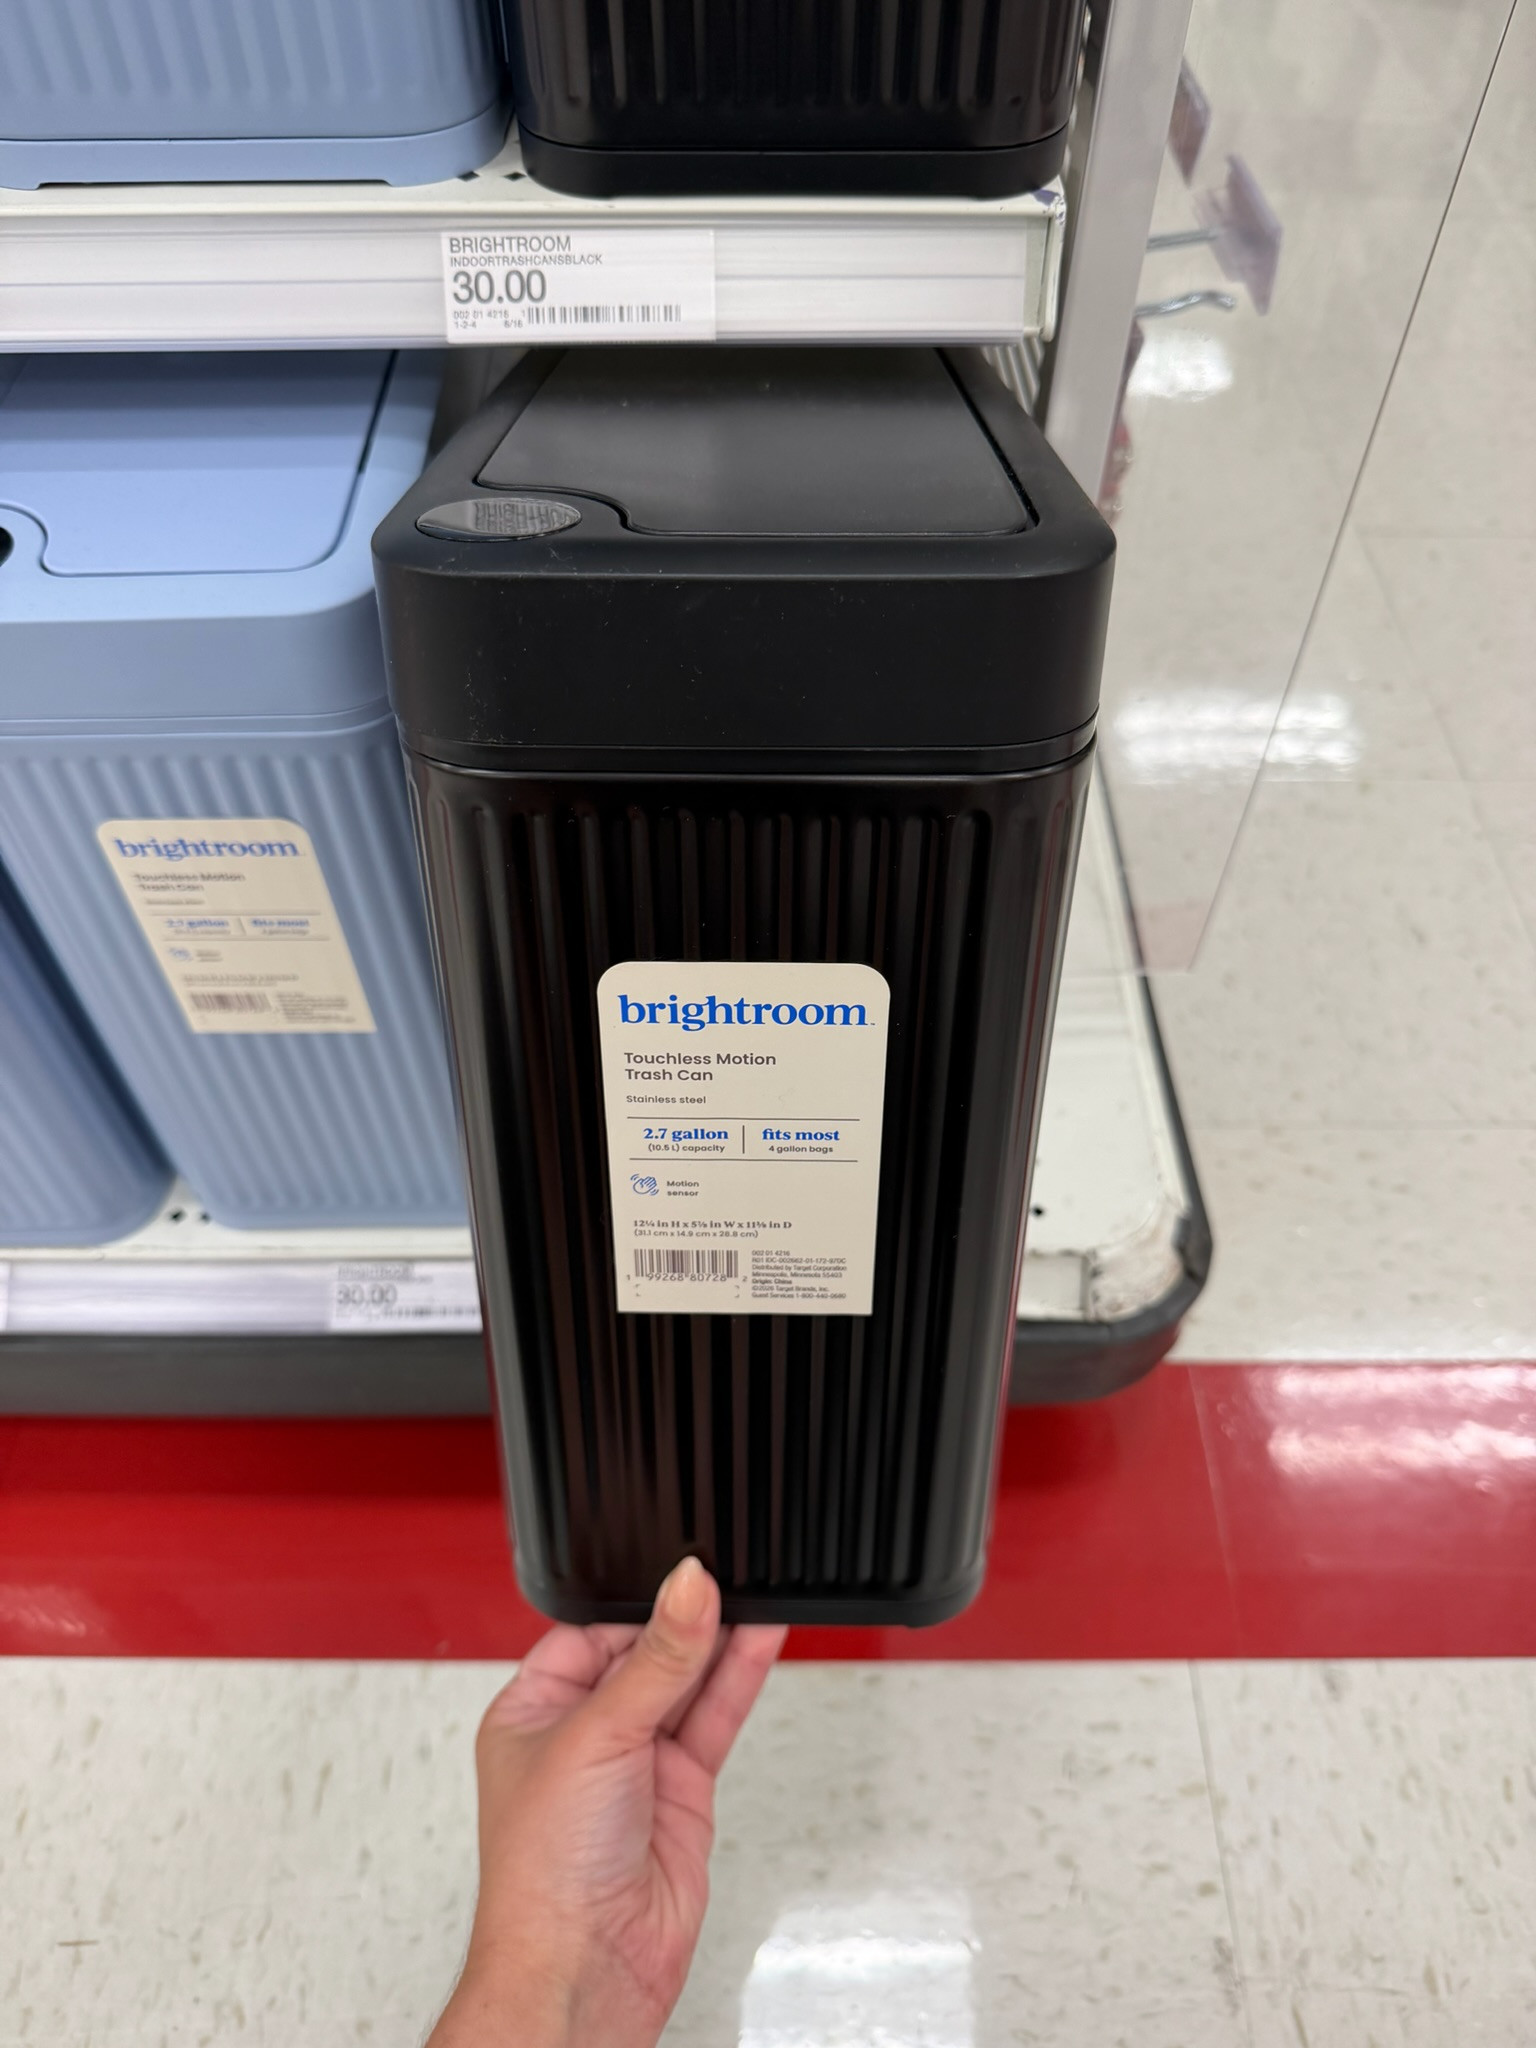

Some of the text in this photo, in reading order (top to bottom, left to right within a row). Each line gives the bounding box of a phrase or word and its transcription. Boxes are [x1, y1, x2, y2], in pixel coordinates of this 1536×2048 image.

[449, 236, 571, 254] BRIGHTROOM
[450, 254, 603, 267] INDOORTRASHCANSBLACK
[453, 269, 547, 304] 30.00
[113, 838, 299, 861] brightroom
[617, 994, 869, 1032] brightroom
[624, 1052, 777, 1065] Touchless Motion
[625, 1068, 713, 1081] Trash Can
[626, 1095, 706, 1104] Stainless steel
[643, 1127, 840, 1142] 2.7 gallon fits most
[647, 1144, 670, 1153] (10.5
[671, 1144, 680, 1153] L)
[682, 1144, 725, 1154] capacity
[776, 1145, 807, 1154] gallon
[809, 1145, 833, 1154] bags
[666, 1180, 699, 1188] Motion
[657, 1220, 669, 1228] in
[671, 1220, 680, 1228] H
[710, 1220, 721, 1228] in
[724, 1221, 735, 1229] W
[769, 1221, 781, 1229] in
[783, 1221, 792, 1229] D
[634, 1229, 651, 1237] (31.1
[695, 1230, 711, 1238] cm
[740, 1229, 758, 1239] cm)
